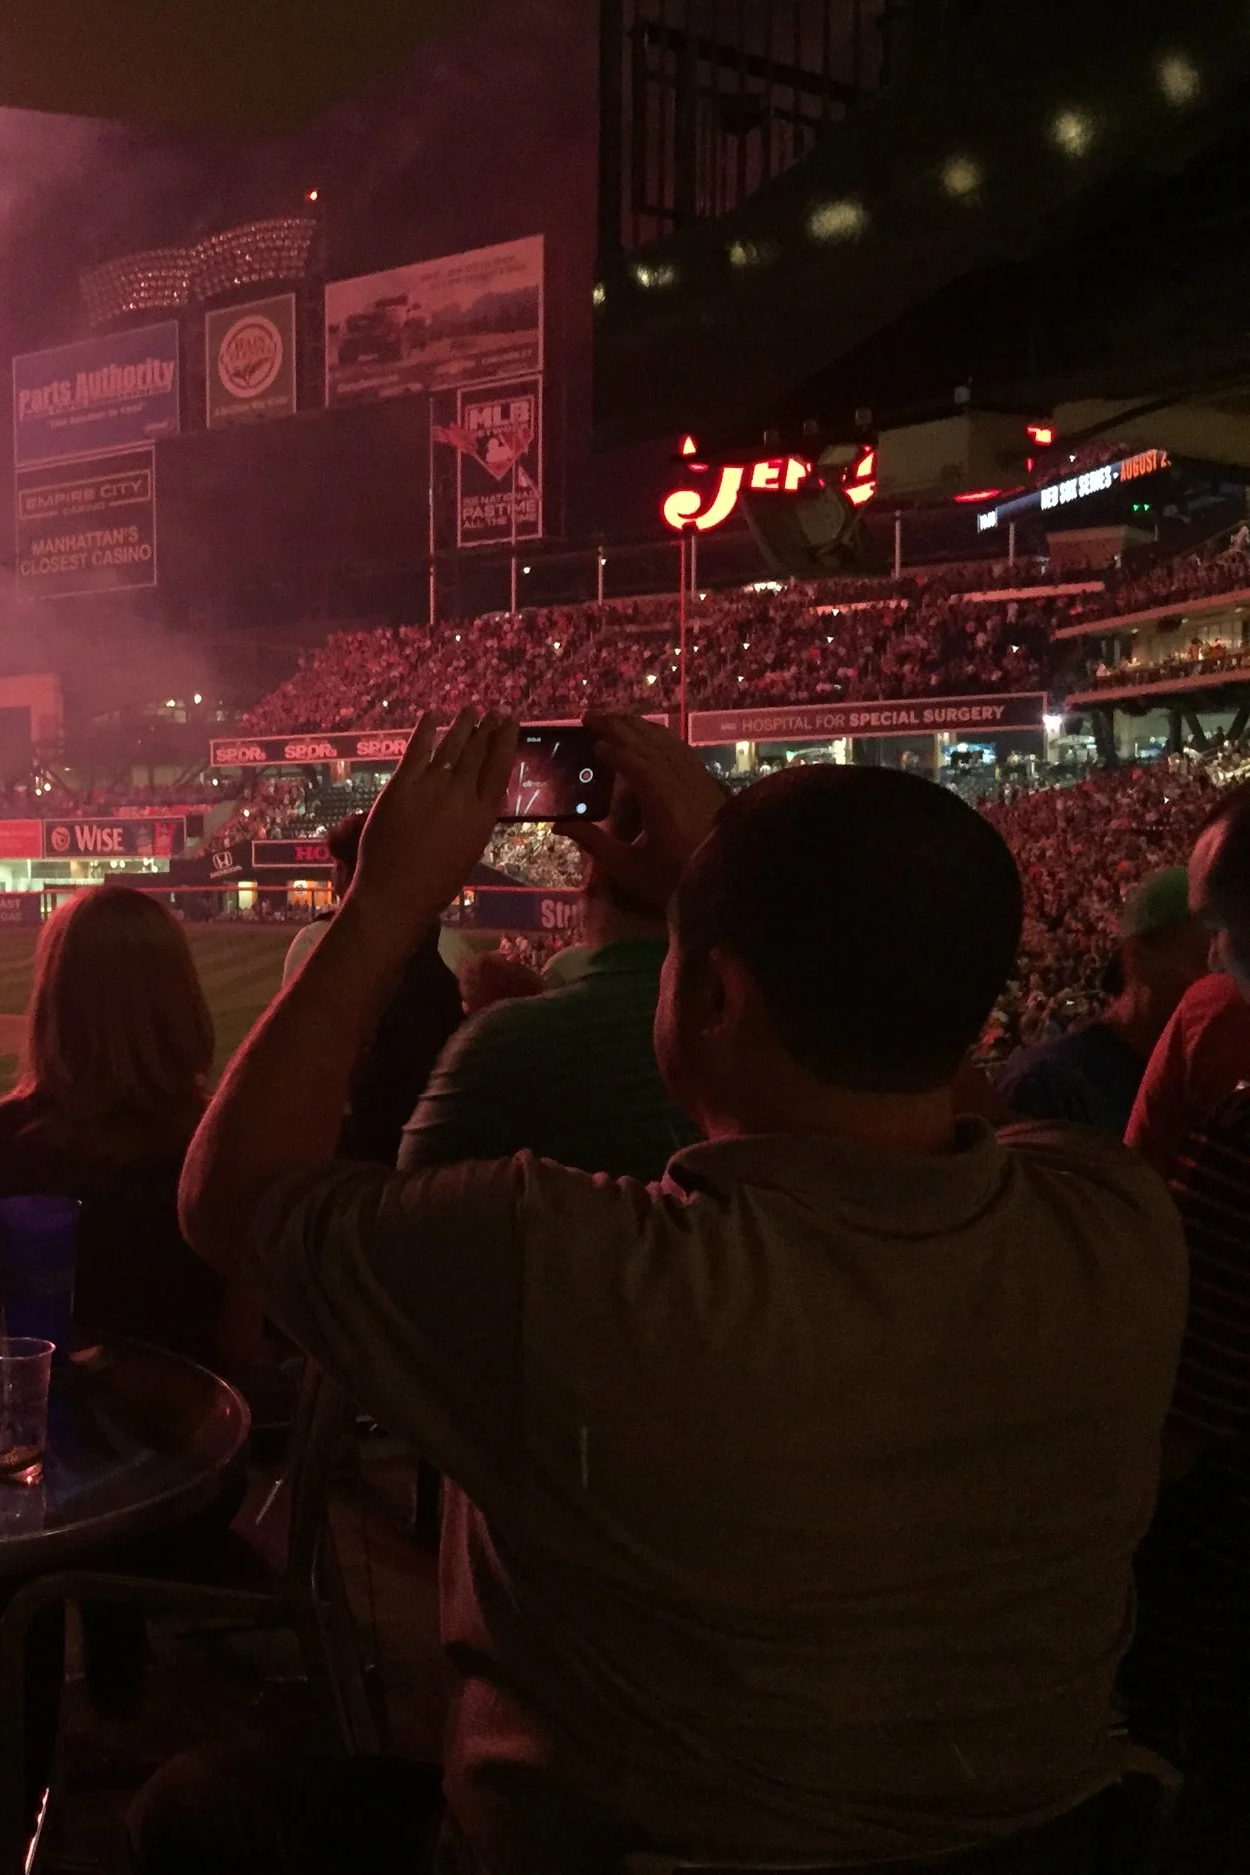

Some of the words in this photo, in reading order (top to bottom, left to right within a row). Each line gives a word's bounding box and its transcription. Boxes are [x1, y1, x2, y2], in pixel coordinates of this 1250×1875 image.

[18, 380, 72, 421] Parts
[75, 357, 175, 407] Authority
[469, 400, 531, 431] MLB
[1119, 449, 1158, 482] AUGUST
[25, 488, 96, 511] EMPIRE
[100, 479, 143, 498] CITY
[462, 501, 537, 520] PASTIME
[31, 525, 139, 557] MANHATTAN'S
[20, 552, 88, 576] CLOSEST
[91, 544, 152, 566] CASINO
[741, 716, 813, 733] HOSPITAL
[815, 714, 846, 729] FOR
[849, 710, 919, 728] SPECIAL
[922, 705, 1005, 723] SURGERY
[75, 825, 124, 852] WISE
[294, 846, 331, 861] HO
